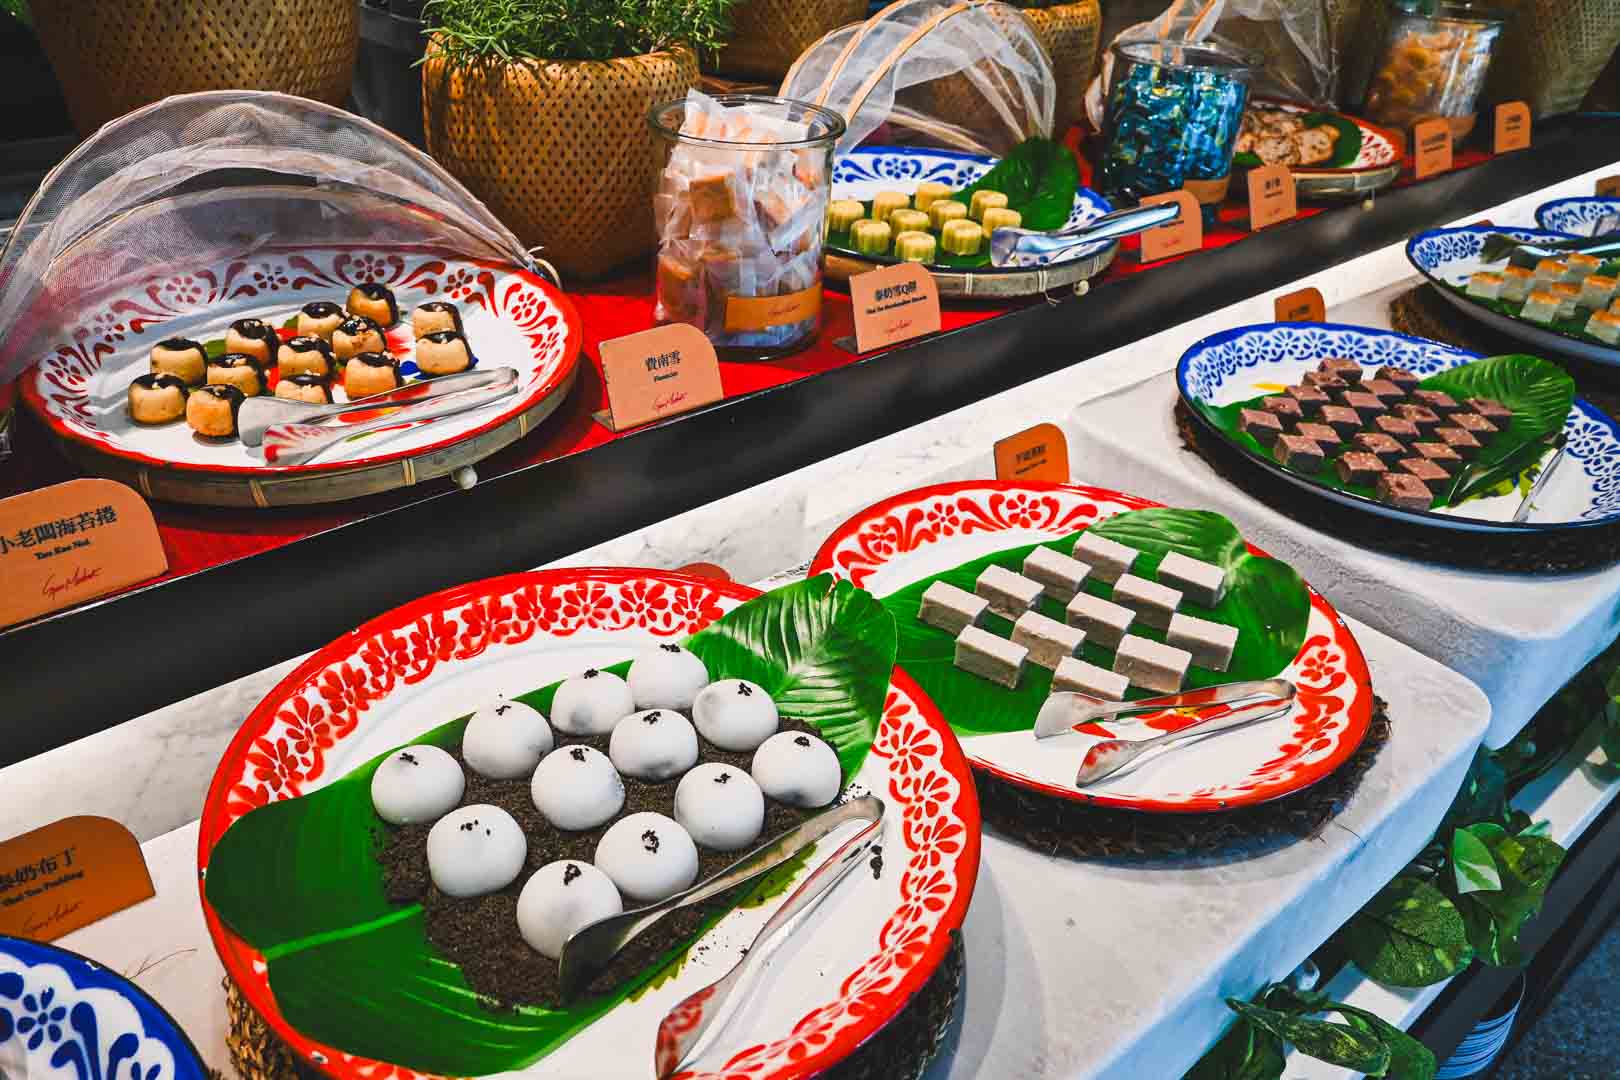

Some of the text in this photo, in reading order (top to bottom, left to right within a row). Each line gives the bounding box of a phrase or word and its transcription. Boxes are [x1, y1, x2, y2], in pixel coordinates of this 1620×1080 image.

[645, 351, 681, 371] 費南雪
[0, 505, 117, 554] 小老闆海苔捲
